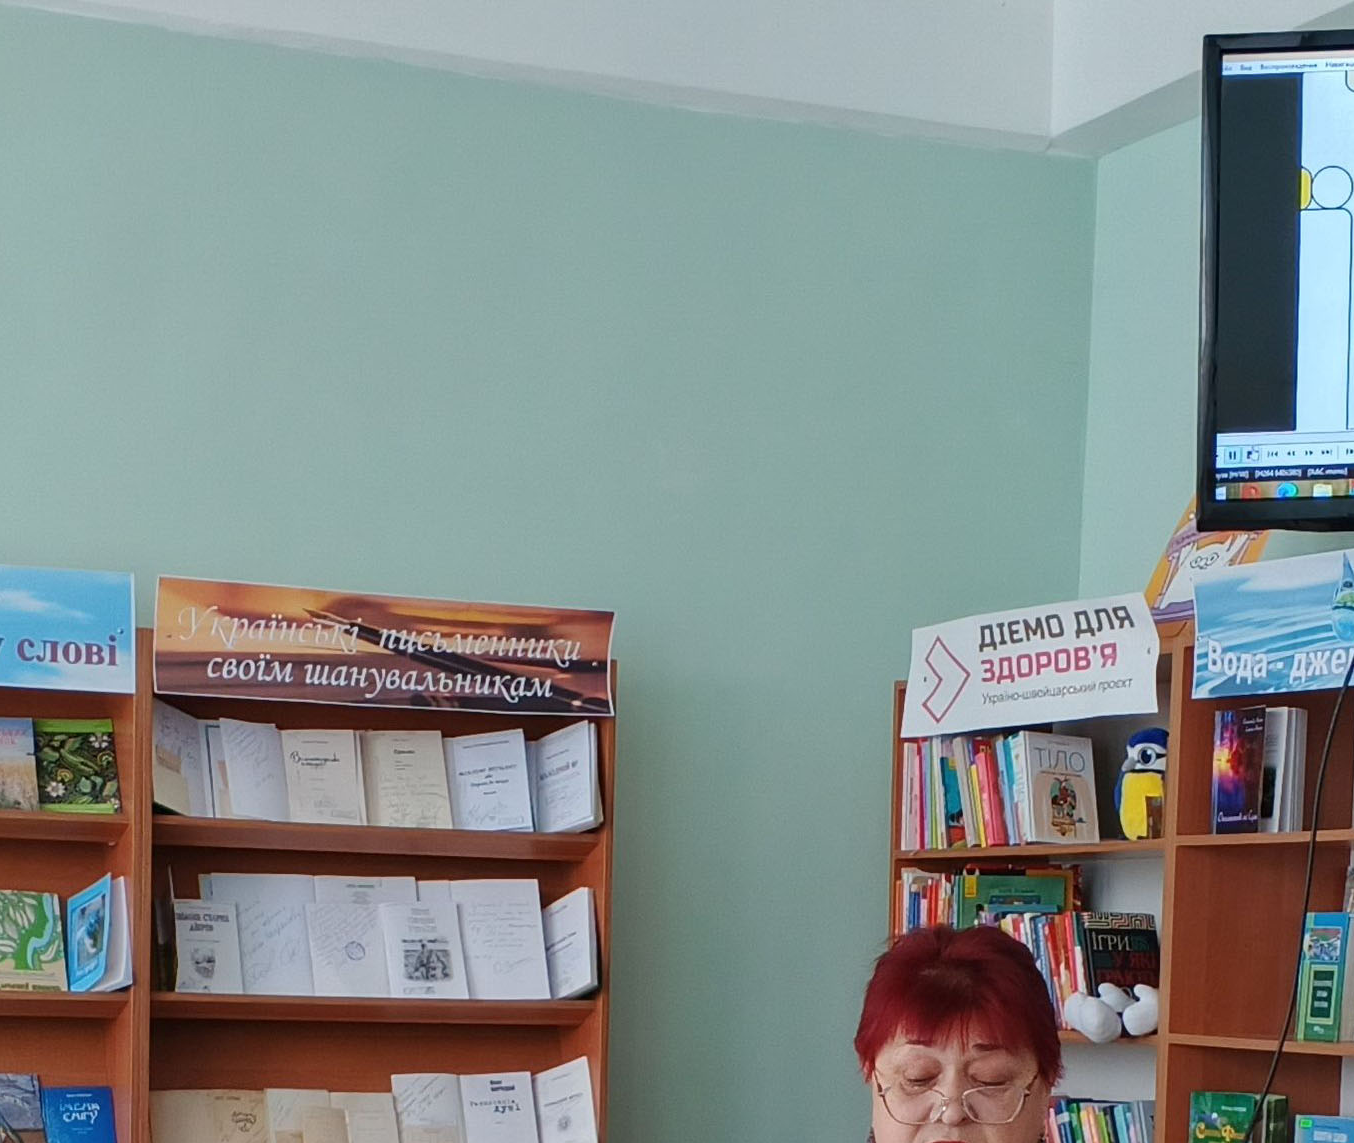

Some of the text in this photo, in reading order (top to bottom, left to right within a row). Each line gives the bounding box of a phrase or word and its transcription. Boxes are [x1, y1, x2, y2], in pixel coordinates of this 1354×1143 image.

[178, 605, 582, 667] Українські письменники
[1074, 605, 1135, 639] ДЛЯ
[16, 634, 119, 666] слові
[1207, 639, 1267, 683] Вода
[207, 652, 554, 703] своїм шанувальникам
[1034, 746, 1086, 773] ТІЛО
[1091, 932, 1131, 951] ІГРИ
